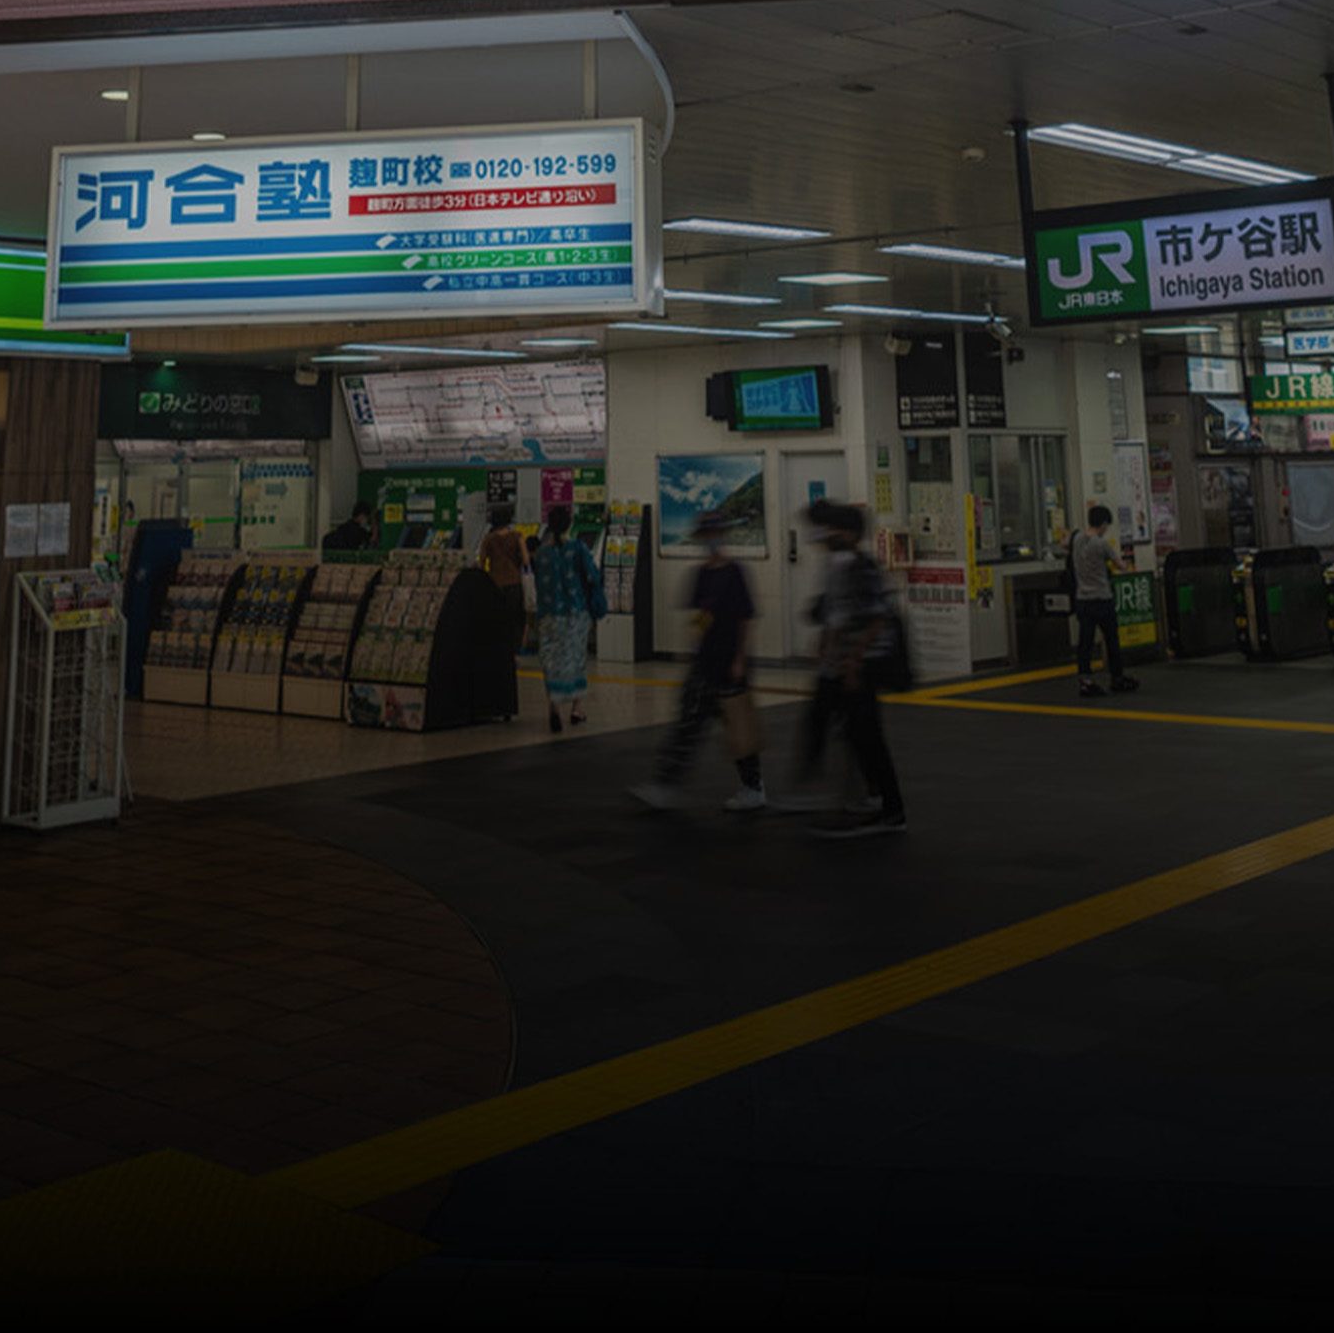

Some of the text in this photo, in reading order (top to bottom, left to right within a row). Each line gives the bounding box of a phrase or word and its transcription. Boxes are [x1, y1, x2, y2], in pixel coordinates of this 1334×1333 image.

[74, 159, 333, 234] 河合塾
[1046, 229, 1137, 290] JR
[1155, 210, 1324, 267] 市ケ谷駅
[1057, 290, 1124, 311] JR東日本
[1159, 264, 1326, 302] Ichigaya Station
